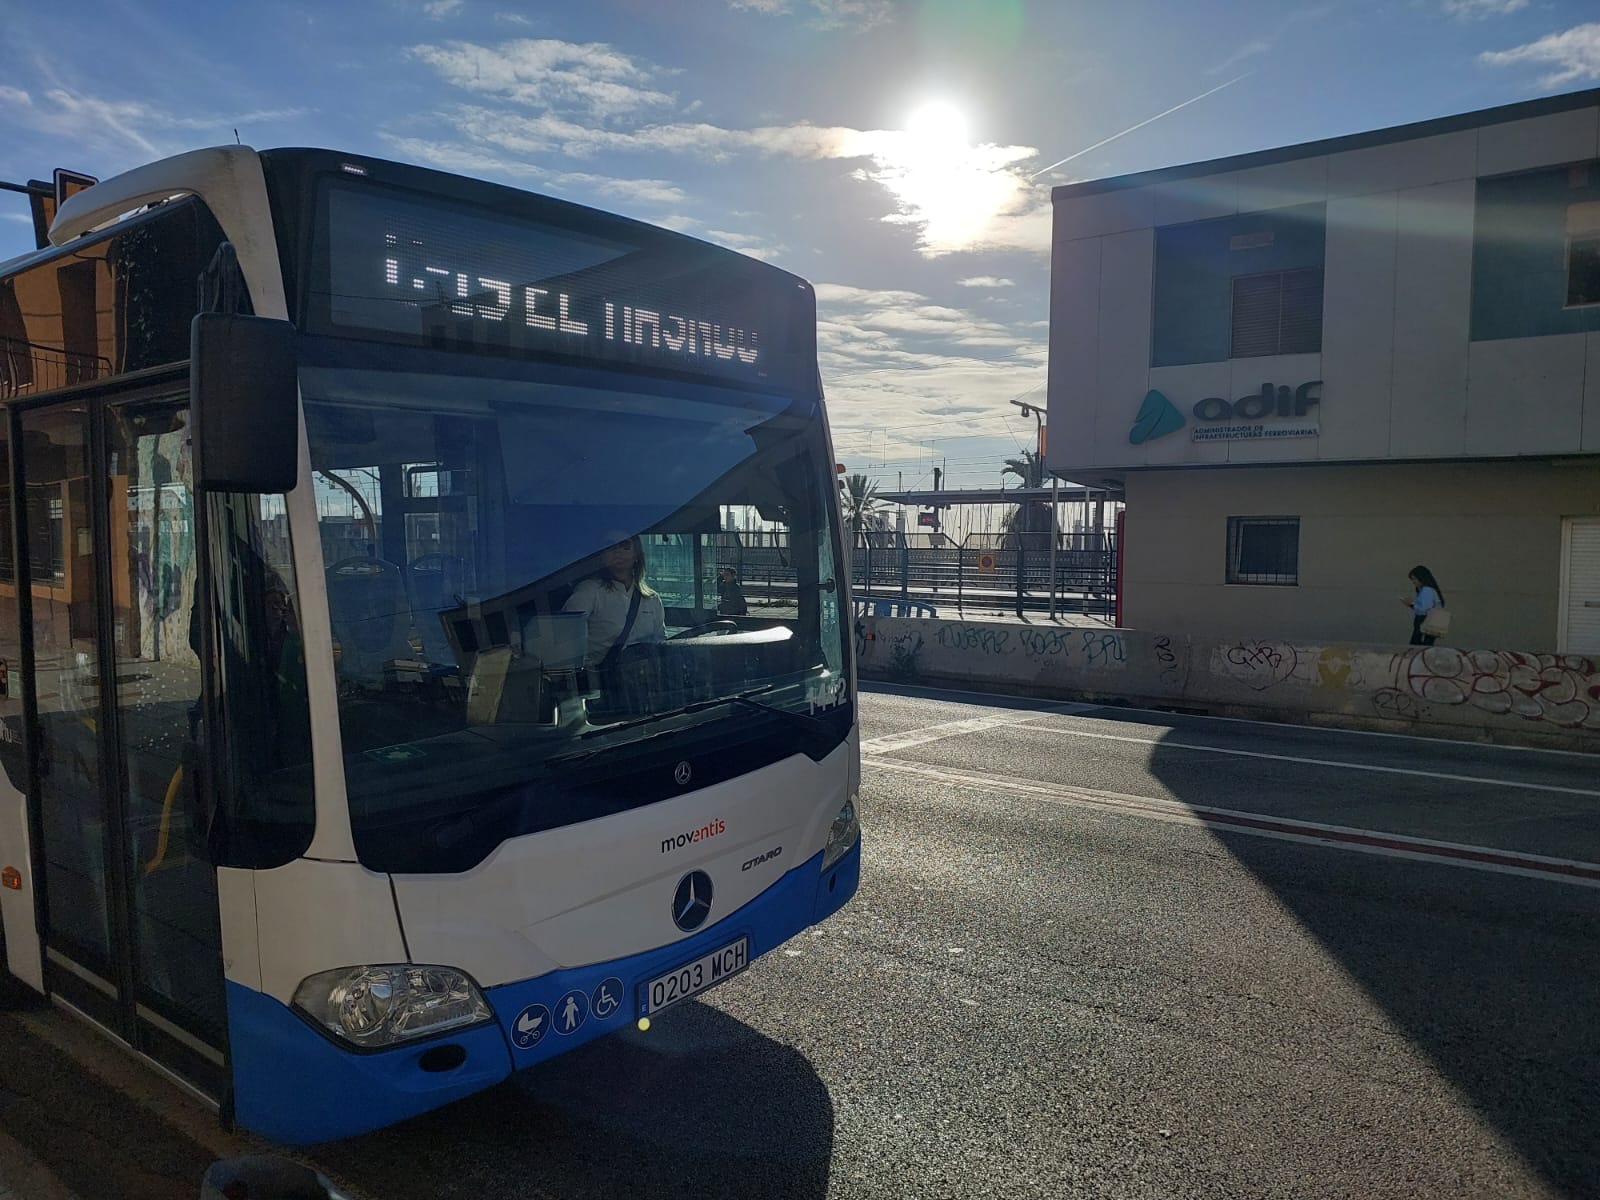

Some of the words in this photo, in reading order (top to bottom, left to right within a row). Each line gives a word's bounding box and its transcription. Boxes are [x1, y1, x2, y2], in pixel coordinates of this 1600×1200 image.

[1192, 380, 1324, 421] adif
[1193, 431, 1263, 441] INFRAESTRUCTURAS
[1264, 428, 1318, 437] FERROVIARIAS
[1194, 425, 1252, 434] ADMINISTRADOR
[661, 817, 726, 853] moventis
[741, 846, 783, 872] CITARO
[652, 964, 703, 1007] 0203
[711, 942, 745, 980] MCH
